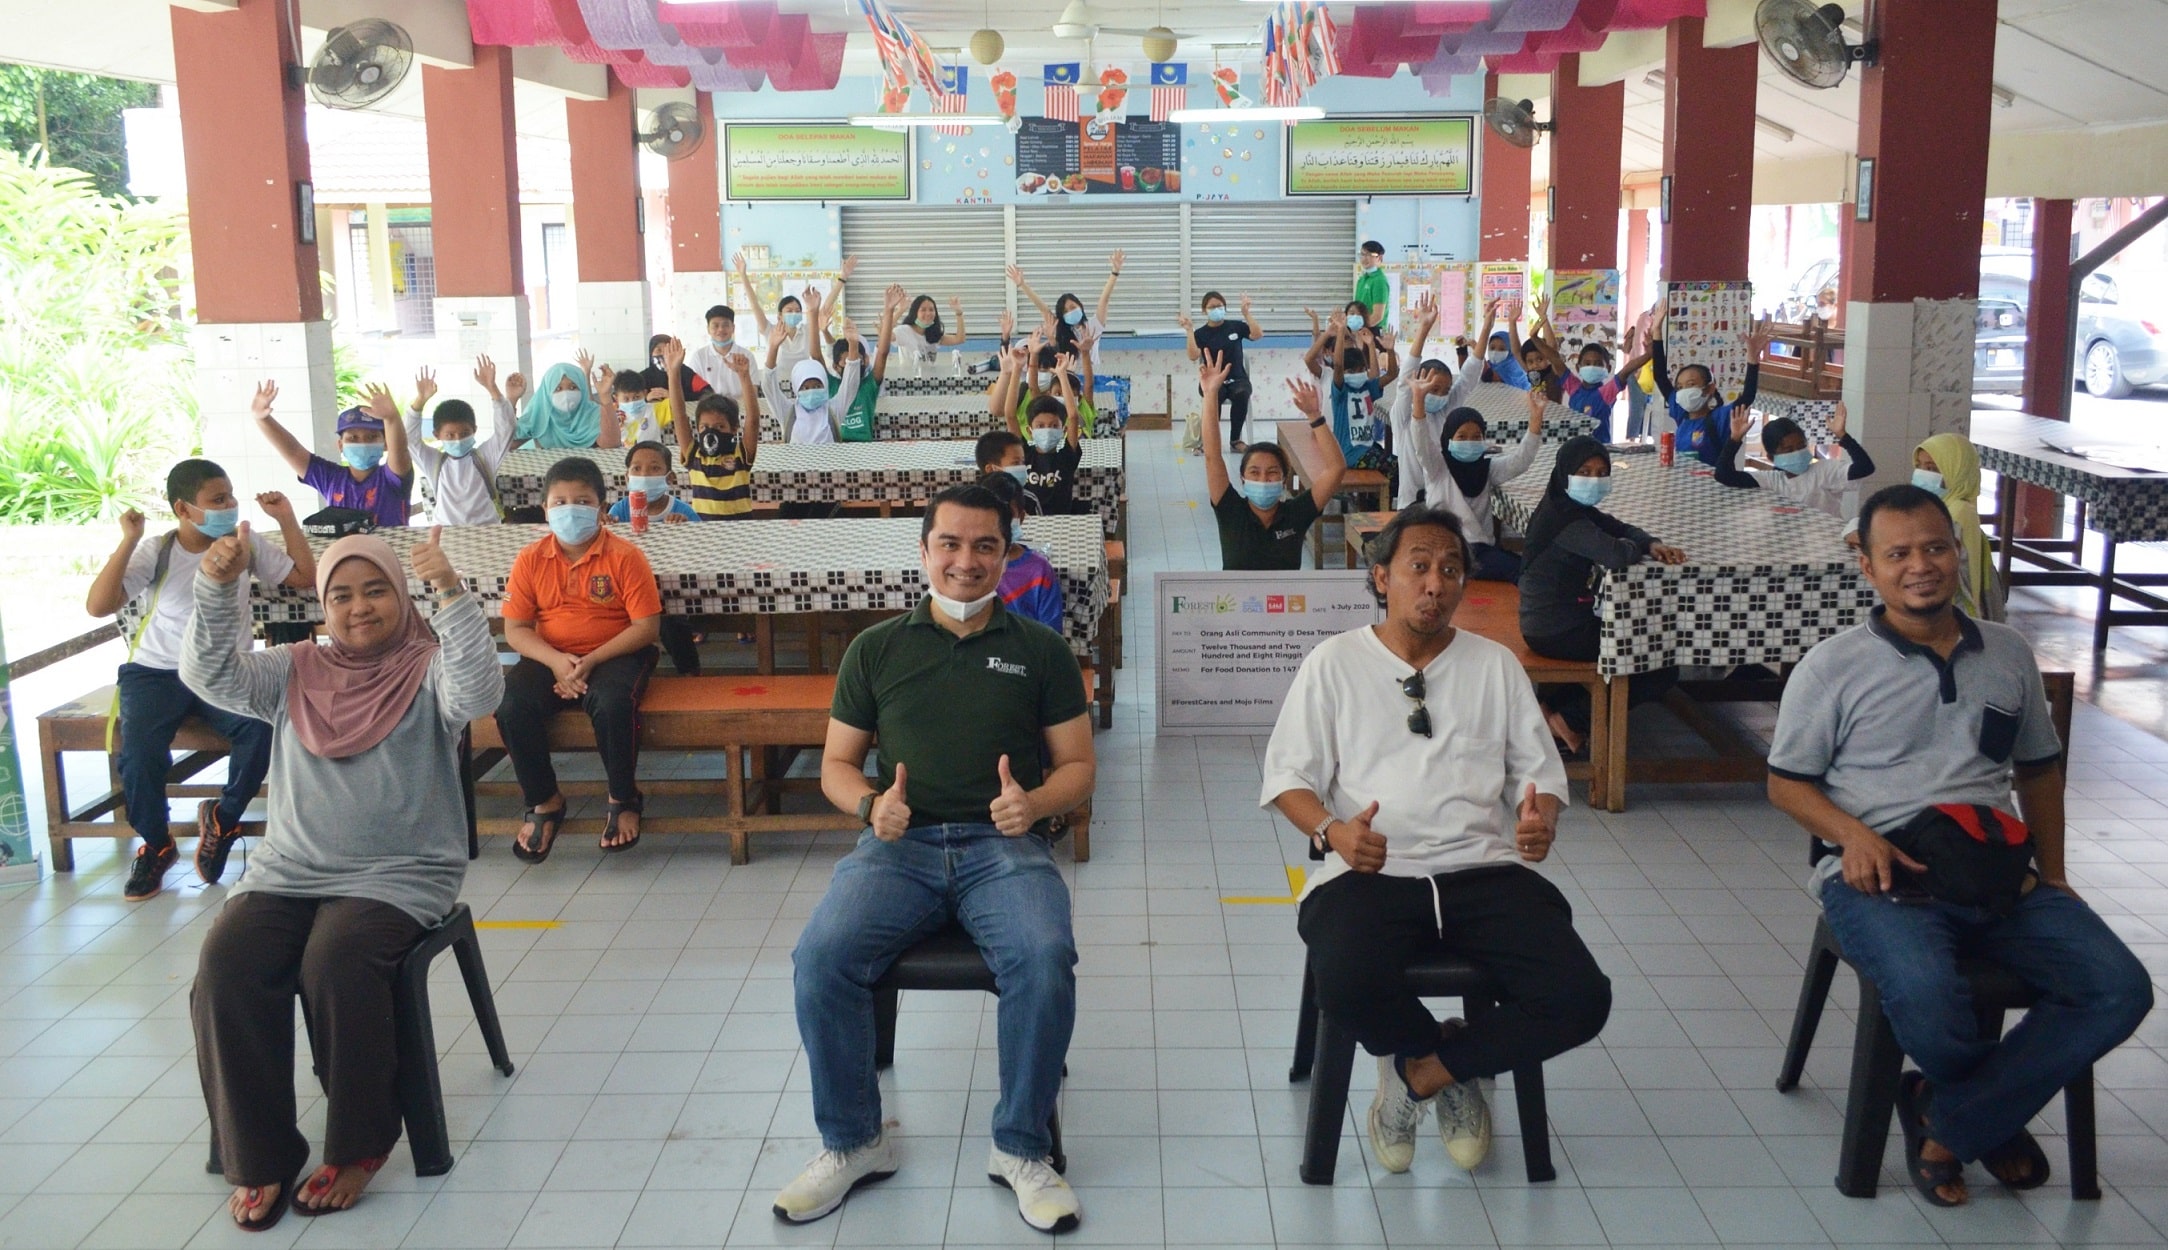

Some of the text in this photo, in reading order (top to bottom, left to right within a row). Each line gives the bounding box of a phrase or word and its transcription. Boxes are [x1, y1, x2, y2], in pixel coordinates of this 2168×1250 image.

[1351, 398, 1365, 420] I
[1337, 603, 1352, 611] July
[1200, 630, 1224, 638] Orang
[1225, 629, 1240, 637] Asli
[1241, 629, 1286, 638] Community
[1253, 652, 1273, 660] Eight
[1275, 652, 1303, 660] Ringgit
